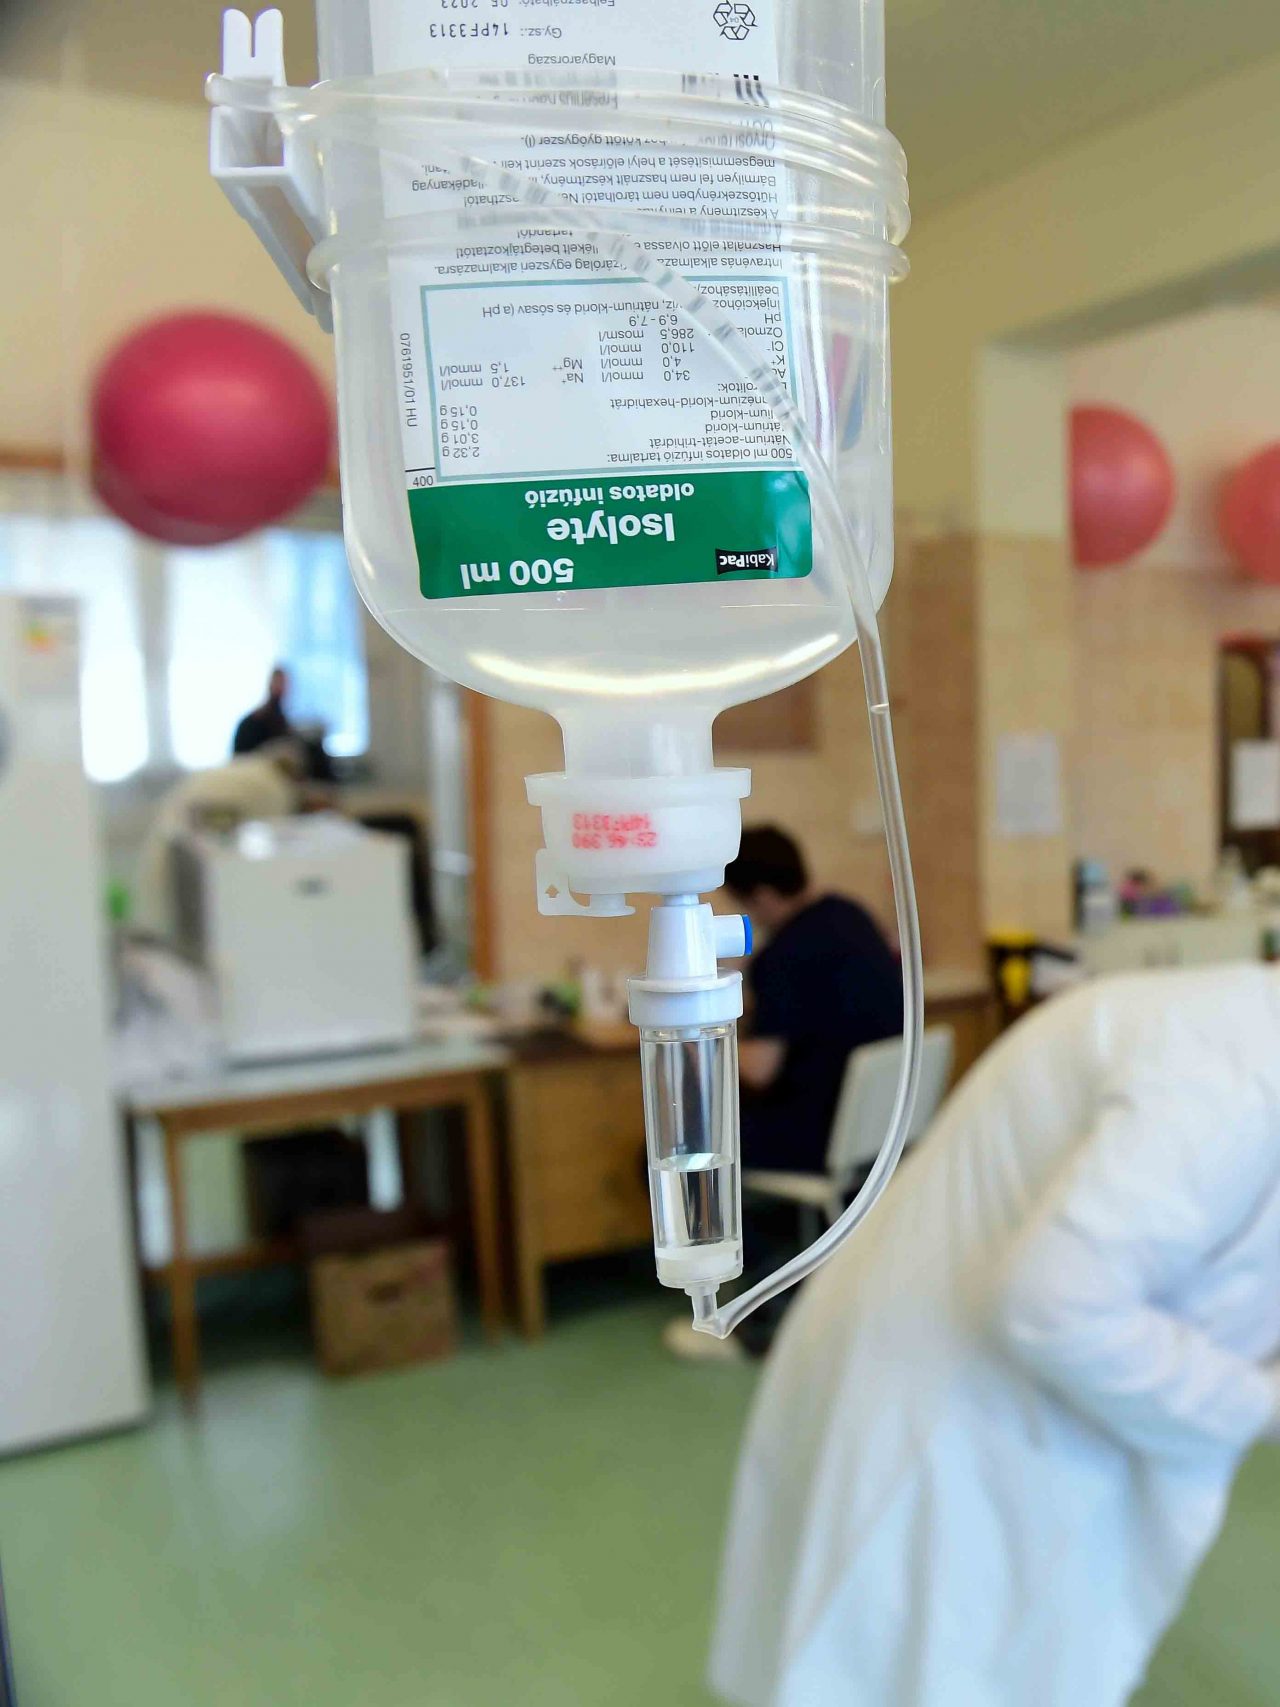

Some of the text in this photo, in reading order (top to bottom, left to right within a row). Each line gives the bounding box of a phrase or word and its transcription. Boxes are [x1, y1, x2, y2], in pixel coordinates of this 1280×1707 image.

[429, 22, 562, 39] Gy.sz.: 14PF3313
[528, 53, 616, 66] Magyarország
[538, 133, 602, 147] gyógyszer
[525, 159, 566, 170] szerint
[569, 158, 625, 170] előírások
[628, 155, 655, 168] helyi
[658, 157, 666, 166] a
[668, 156, 775, 168] megsemmisítését
[541, 173, 613, 187] készítmény,
[617, 174, 667, 185] használt
[670, 174, 696, 183] nem
[700, 174, 714, 185] fel
[717, 172, 776, 186] Bármilyen
[561, 192, 578, 203] Ne
[582, 191, 639, 203] tárolható!
[642, 191, 669, 200] nem
[671, 188, 777, 203] Hűtőszekrényben
[456, 243, 559, 259] betegtájkoztatót!
[643, 241, 690, 252] olvassa
[693, 241, 719, 252] előtt
[435, 257, 782, 276] Intravénás alkalmaz zárólag egyszeri alkalmazásra.
[556, 304, 571, 313] és
[575, 301, 659, 315] nátrium-klorid
[712, 296, 780, 310] Injekcióhoz
[482, 304, 500, 318] pH
[503, 303, 515, 316] (a
[517, 305, 554, 315] sósav
[629, 315, 648, 327] 7,9
[659, 314, 678, 325] 6,9
[764, 311, 781, 324] pH
[598, 329, 644, 341] mosm/l
[660, 327, 694, 339] 286,5
[599, 343, 641, 355] mmol/l
[661, 341, 695, 354] 110,0
[600, 357, 643, 368] mmol/l
[662, 355, 681, 367] 4,0
[439, 363, 482, 377] mmol/l
[490, 362, 509, 374] 1,5
[400, 333, 417, 427] 0761951/01 HU
[601, 371, 644, 382] mmol/l
[663, 369, 690, 381] 34,0
[441, 378, 483, 390] mmol/l
[491, 375, 525, 388] 137,0
[439, 396, 767, 417] nézium-klorid-hexahidrát 0,15 g
[440, 409, 773, 430] lium-klorid 0,15 g
[441, 422, 784, 444] átrium-klorid 3,01 g
[442, 446, 450, 457] g
[453, 446, 480, 458] 2,32
[607, 448, 792, 463] 500 ml oldatos infúzió tartalma:
[412, 475, 433, 487] 400
[524, 483, 695, 508] oldatos infúzió
[547, 510, 675, 545] Isolyte
[719, 553, 775, 568] KabiPac
[460, 558, 574, 589] 500 ml
